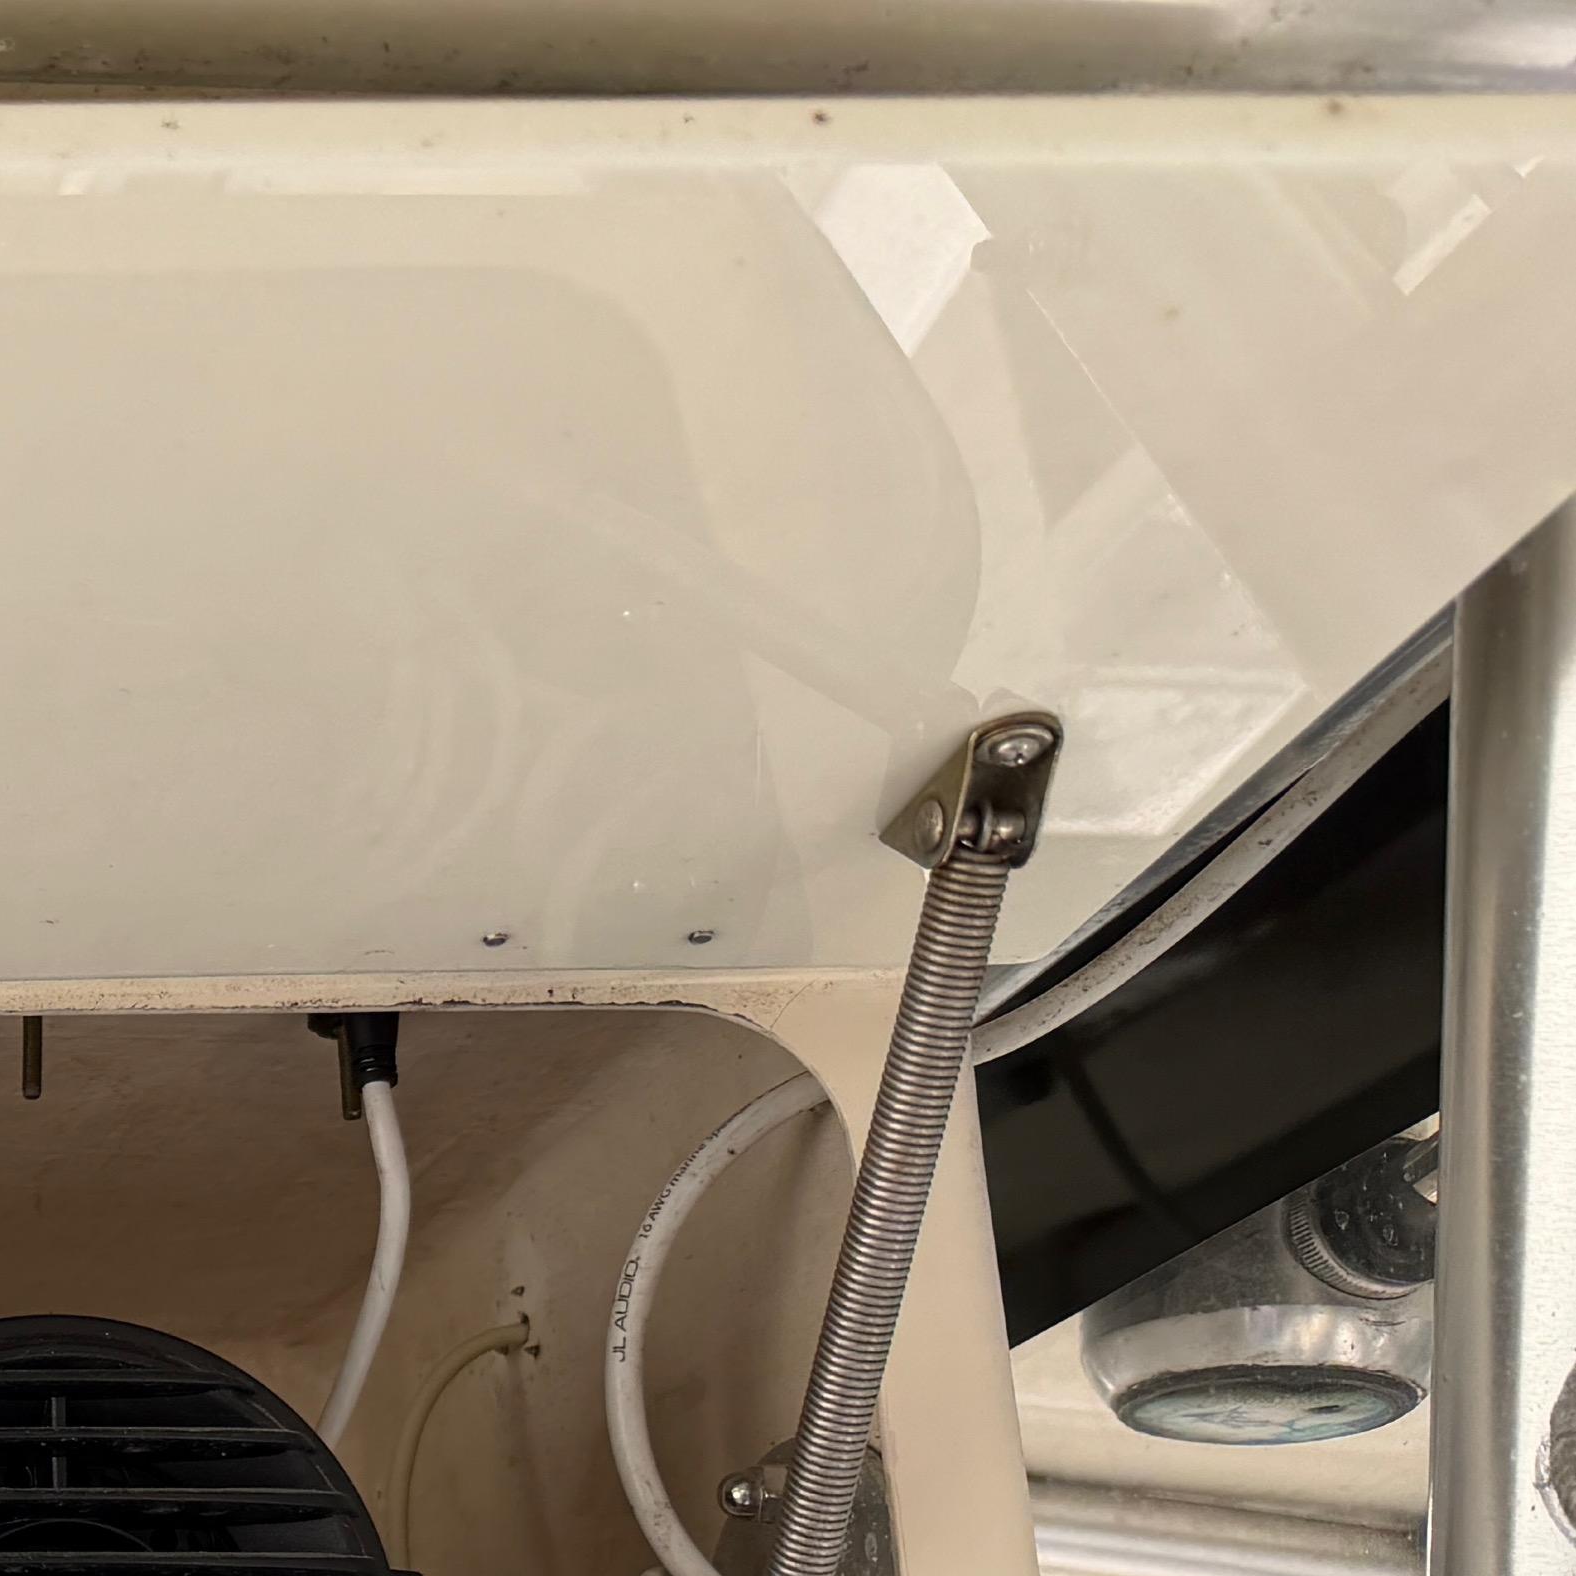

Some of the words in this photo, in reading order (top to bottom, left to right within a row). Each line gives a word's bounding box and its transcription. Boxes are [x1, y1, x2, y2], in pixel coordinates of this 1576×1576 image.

[639, 1222, 653, 1239] 16
[648, 1188, 672, 1222] AWG
[668, 1141, 707, 1188] marine
[612, 1336, 627, 1363] JL
